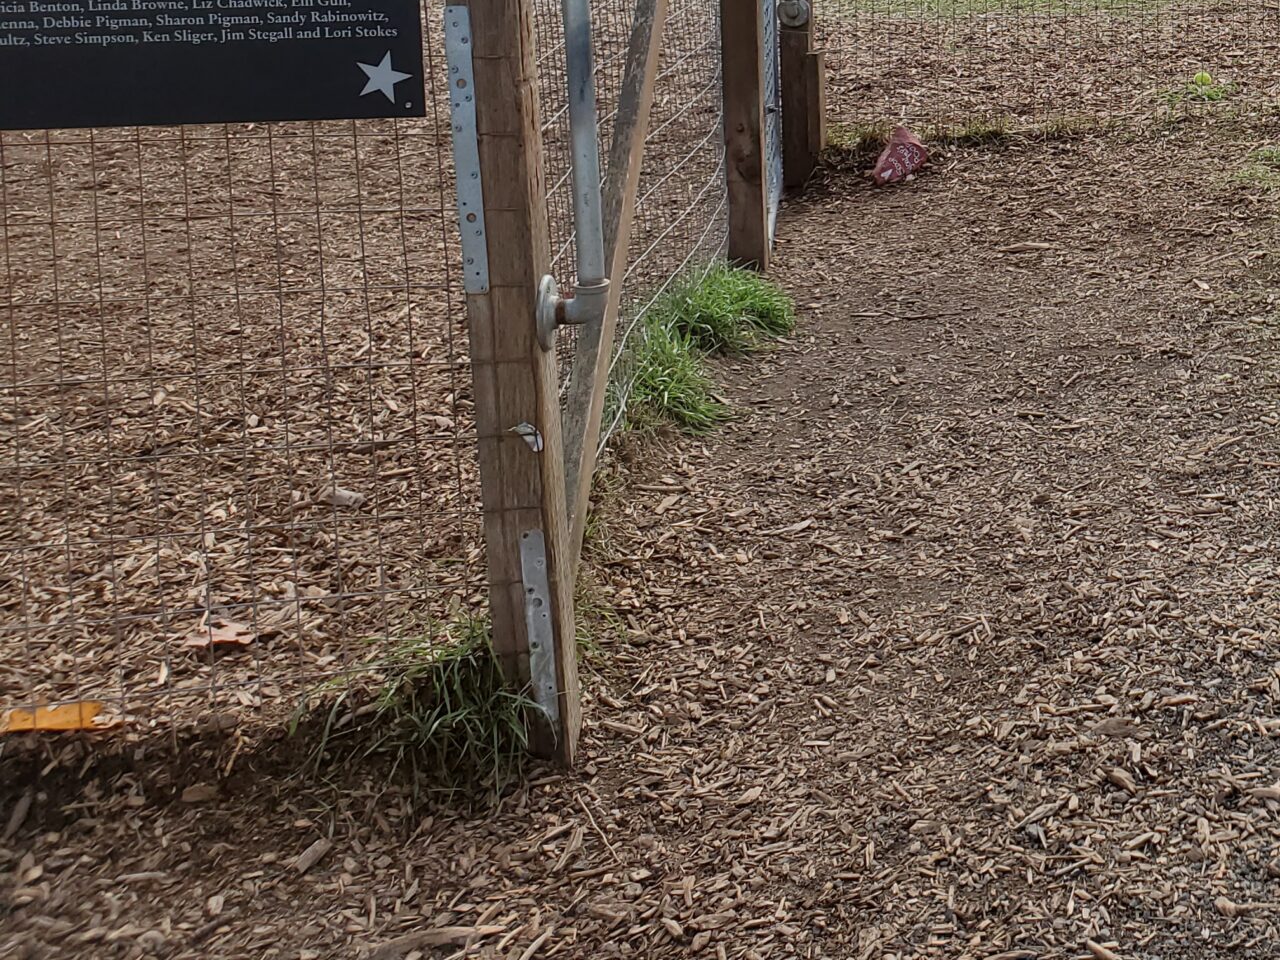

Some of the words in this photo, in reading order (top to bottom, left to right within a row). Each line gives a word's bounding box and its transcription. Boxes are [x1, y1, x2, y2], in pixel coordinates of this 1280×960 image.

[0, 1, 25, 12] icia
[29, 1, 84, 12] Benton,
[0, 19, 38, 31] enna,
[43, 15, 91, 28] Debbie
[95, 15, 152, 29] Pigman,
[156, 13, 204, 25] Sharon
[208, 13, 263, 27] Pigman,
[266, 10, 306, 28] Sandy
[310, 9, 388, 24] Rabinowitz,
[0, 33, 30, 46] ultz,
[33, 33, 70, 44] Steve
[74, 32, 138, 46] Simpson,
[142, 30, 170, 41] Ken
[174, 29, 217, 44] Sliger,
[219, 28, 244, 43] Jim
[248, 27, 292, 42] Stegall
[296, 26, 320, 38] and
[324, 26, 351, 37] Lori
[355, 25, 397, 37] Stokes
